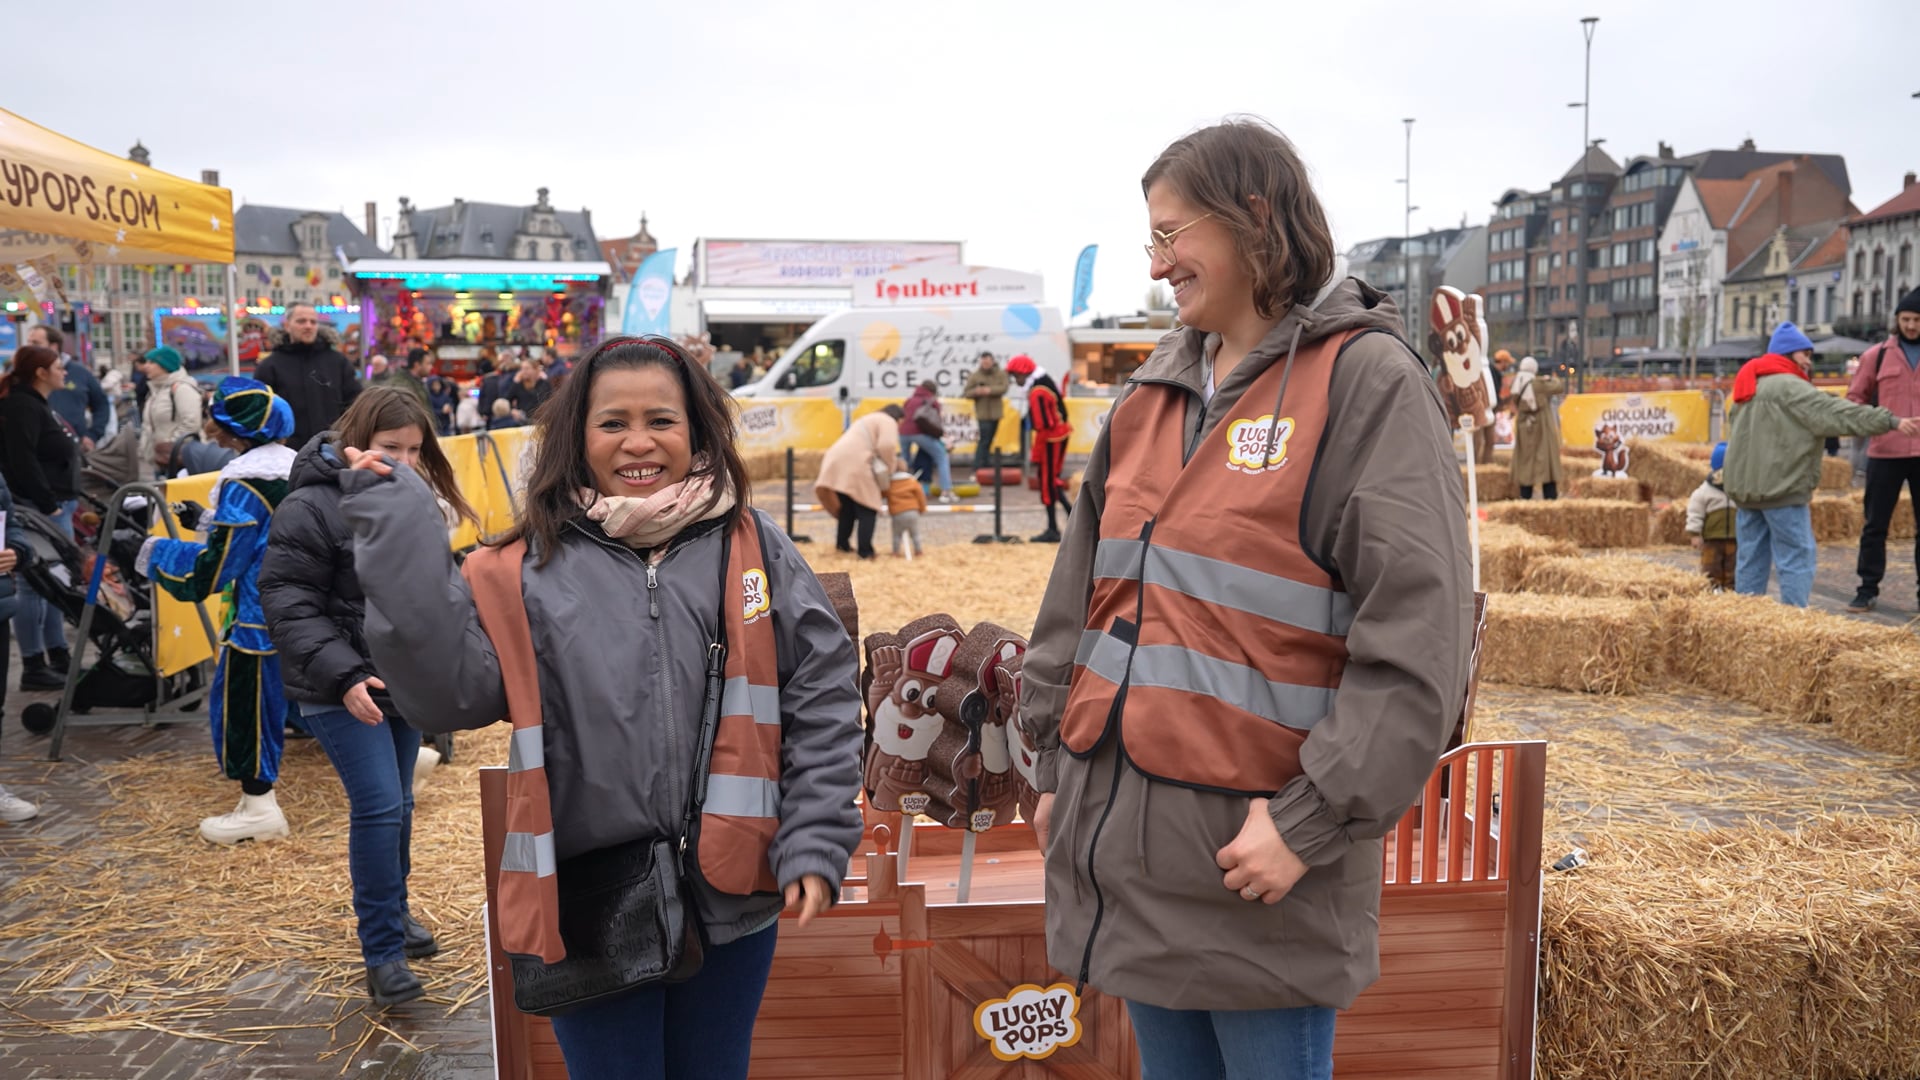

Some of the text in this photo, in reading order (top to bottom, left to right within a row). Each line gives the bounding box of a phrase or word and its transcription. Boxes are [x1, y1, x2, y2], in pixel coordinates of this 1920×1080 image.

[0, 159, 162, 231] YPOPS.COM
[876, 278, 978, 301] foubert
[914, 325, 992, 350] Please
[868, 371, 919, 389] ICE
[1601, 406, 1667, 421] CHOCOLADE
[1619, 421, 1675, 436] IPOPRACE
[990, 995, 1067, 1032] LUCKY
[1002, 1019, 1068, 1051] POPS
